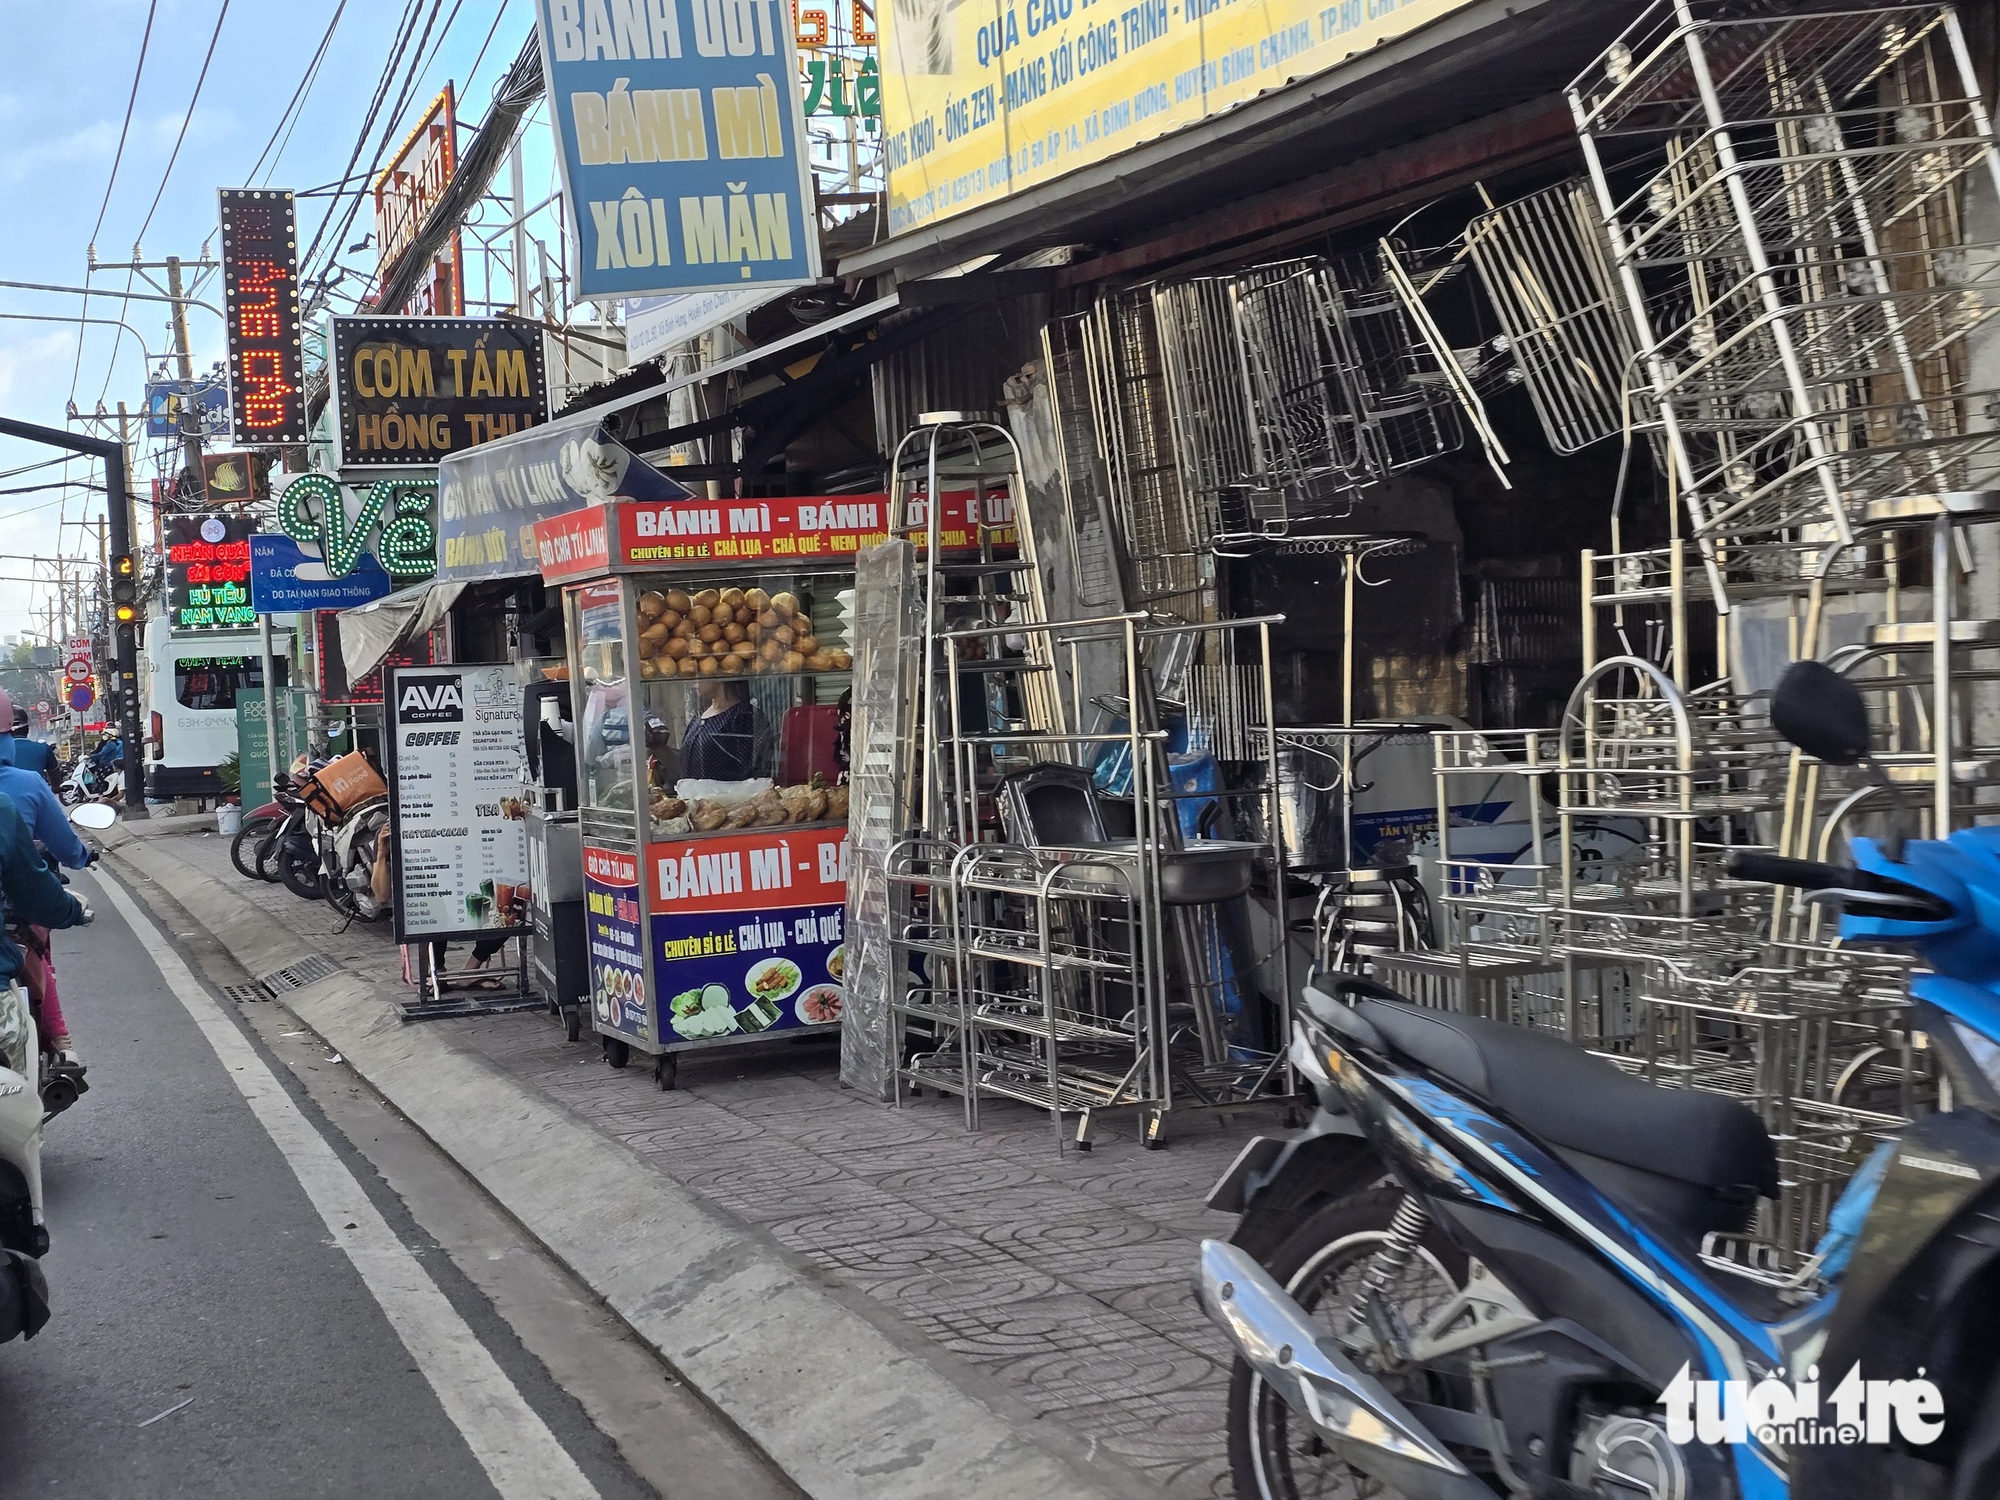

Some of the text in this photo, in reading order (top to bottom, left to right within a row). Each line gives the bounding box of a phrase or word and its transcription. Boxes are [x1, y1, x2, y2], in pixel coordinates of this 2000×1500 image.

[910, 109, 935, 162] KHÓI
[945, 92, 968, 143] ỐNG
[971, 83, 995, 127] ZEN
[1006, 58, 1046, 112] MÁNG
[1050, 28, 1073, 91] XỐI
[1078, 22, 1117, 76] CÔNG
[1103, 100, 1130, 137] BÌNH
[1221, 46, 1255, 86] BÌNH
[571, 78, 708, 165] BÁNH
[712, 73, 784, 160] MÌ
[589, 182, 793, 278] XÔI MẶN
[355, 333, 530, 398] CƠM TẤM
[357, 402, 451, 450] HỒNG
[443, 454, 569, 522] GIÒ CHẢ TÚ LINH
[636, 506, 720, 537] BÁNH
[729, 503, 771, 533] MÌ
[798, 501, 878, 530] BÁNH
[171, 540, 215, 562] NHÂN
[255, 547, 275, 557] NĂM
[446, 531, 485, 567] BÁNH
[540, 531, 553, 566] GIÒ
[554, 523, 570, 562] CHẢ
[571, 523, 584, 559] TÚ
[586, 526, 605, 556] LINH
[630, 547, 671, 560] CHUYÊN
[674, 543, 684, 558] SỈ
[714, 535, 738, 556] CHẢ
[740, 539, 762, 559] LỤA
[773, 532, 796, 554] CHẢ
[798, 532, 821, 554] QUẾ
[831, 535, 857, 551] NEM
[187, 562, 245, 582] SÀI GÒN
[272, 589, 284, 599] DO
[287, 589, 299, 599] TAI
[321, 588, 340, 598] GIAO
[343, 587, 371, 598] THÔNG
[181, 606, 257, 624] NAM VANG
[400, 685, 463, 711] AVA
[244, 709, 266, 718] FOO
[411, 711, 452, 719] COFFEE
[475, 709, 518, 723] Signature
[250, 748, 268, 758] QUỐ
[405, 731, 460, 747] COFFEE
[475, 803, 499, 817] TEA
[1379, 824, 1400, 837] TÂN
[588, 851, 598, 874] GIÒ
[620, 862, 635, 881] LINH
[658, 848, 742, 900] BÁNH
[749, 840, 791, 890] MÌ
[665, 939, 701, 958] CHUYÊN
[703, 931, 713, 953] SỈ
[739, 916, 762, 952] CHẢ
[764, 921, 786, 953] LỤA
[795, 910, 818, 945] CHẢ
[819, 908, 842, 944] QUẾ
